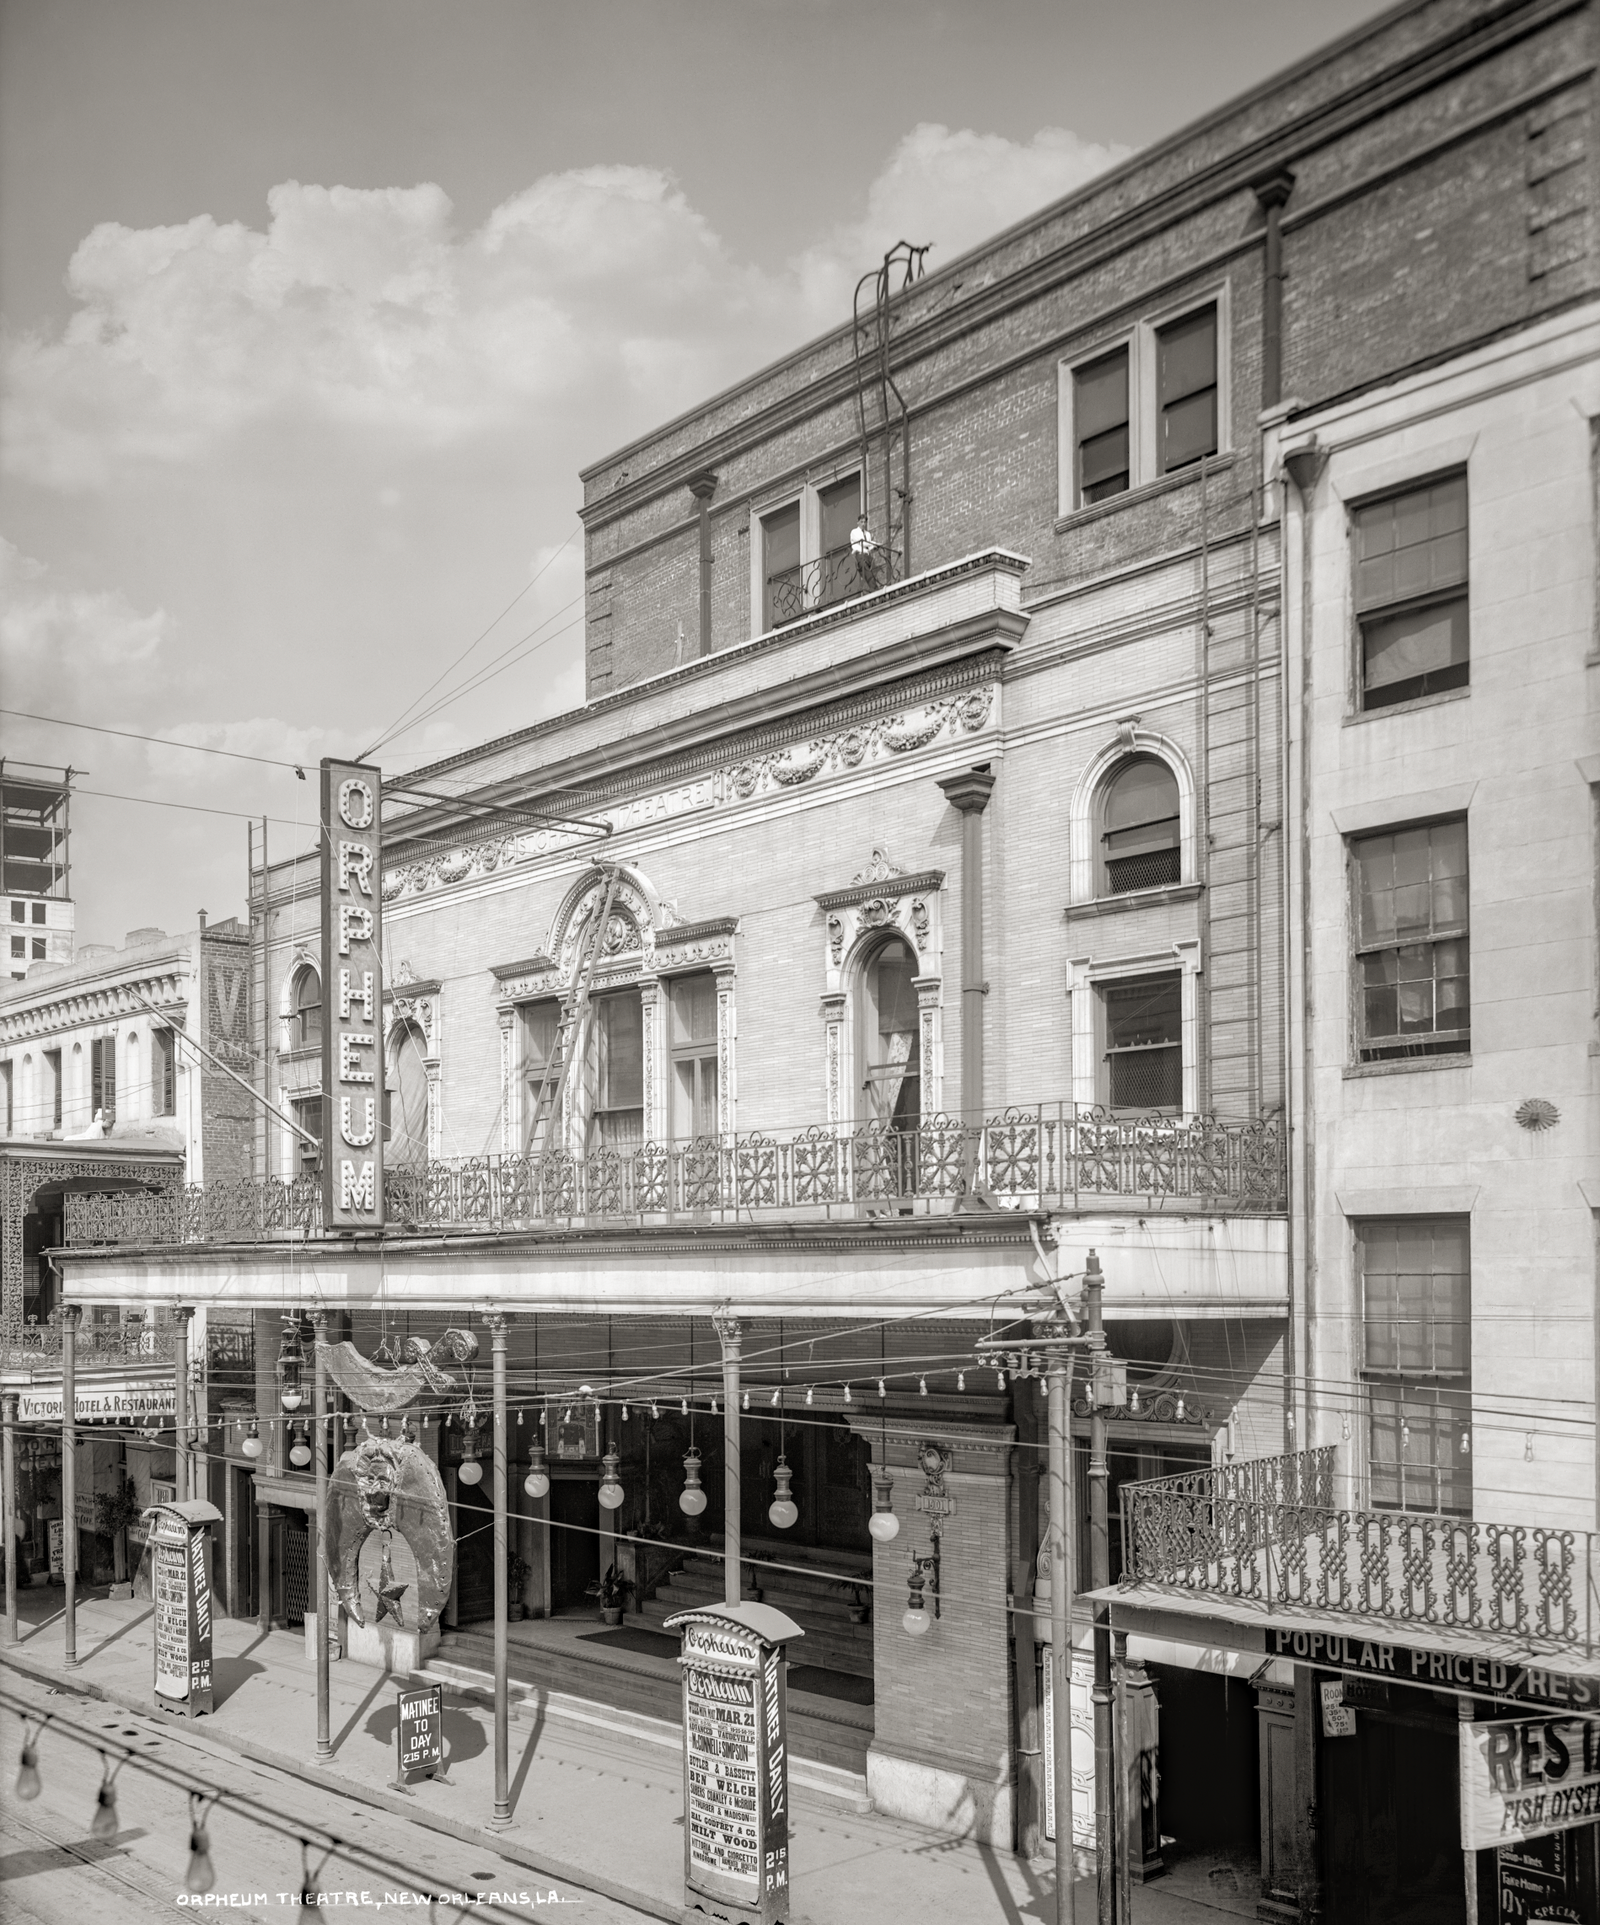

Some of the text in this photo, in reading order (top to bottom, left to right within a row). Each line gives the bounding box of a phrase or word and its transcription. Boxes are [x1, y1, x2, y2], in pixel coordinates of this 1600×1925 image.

[618, 783, 709, 831] THEATRE.
[338, 778, 375, 1211] ORPHEUM
[23, 1397, 62, 1416] VICTORI
[103, 1396, 113, 1411] &
[114, 1395, 176, 1411] RESTAURANT
[190, 1525, 211, 1642] MATINEE DAILY
[689, 1627, 756, 1659] Orpheum
[1275, 1631, 1592, 1703] POPULAR PRICED RES
[689, 1669, 752, 1703] Orpheum
[401, 1697, 439, 1721] MATINEE
[716, 1707, 743, 1726] MAR.
[744, 1713, 755, 1727] 21
[414, 1718, 428, 1733] TO
[717, 1729, 755, 1745] VAUDEVILLE
[764, 1645, 784, 1820] MATINEE DAILY
[410, 1732, 432, 1750] DAY
[722, 1740, 749, 1762] SIMPSON
[689, 1754, 756, 1781] BUTLER & BASSETT
[689, 1769, 756, 1797] BEN WELCH
[728, 1796, 733, 1806] &
[691, 1811, 756, 1837] HAL GODFREY & CO.
[717, 1807, 722, 1815] &
[724, 1809, 749, 1822] MADISON
[691, 1822, 757, 1850] MILT WOOD
[714, 1846, 725, 1857] AND
